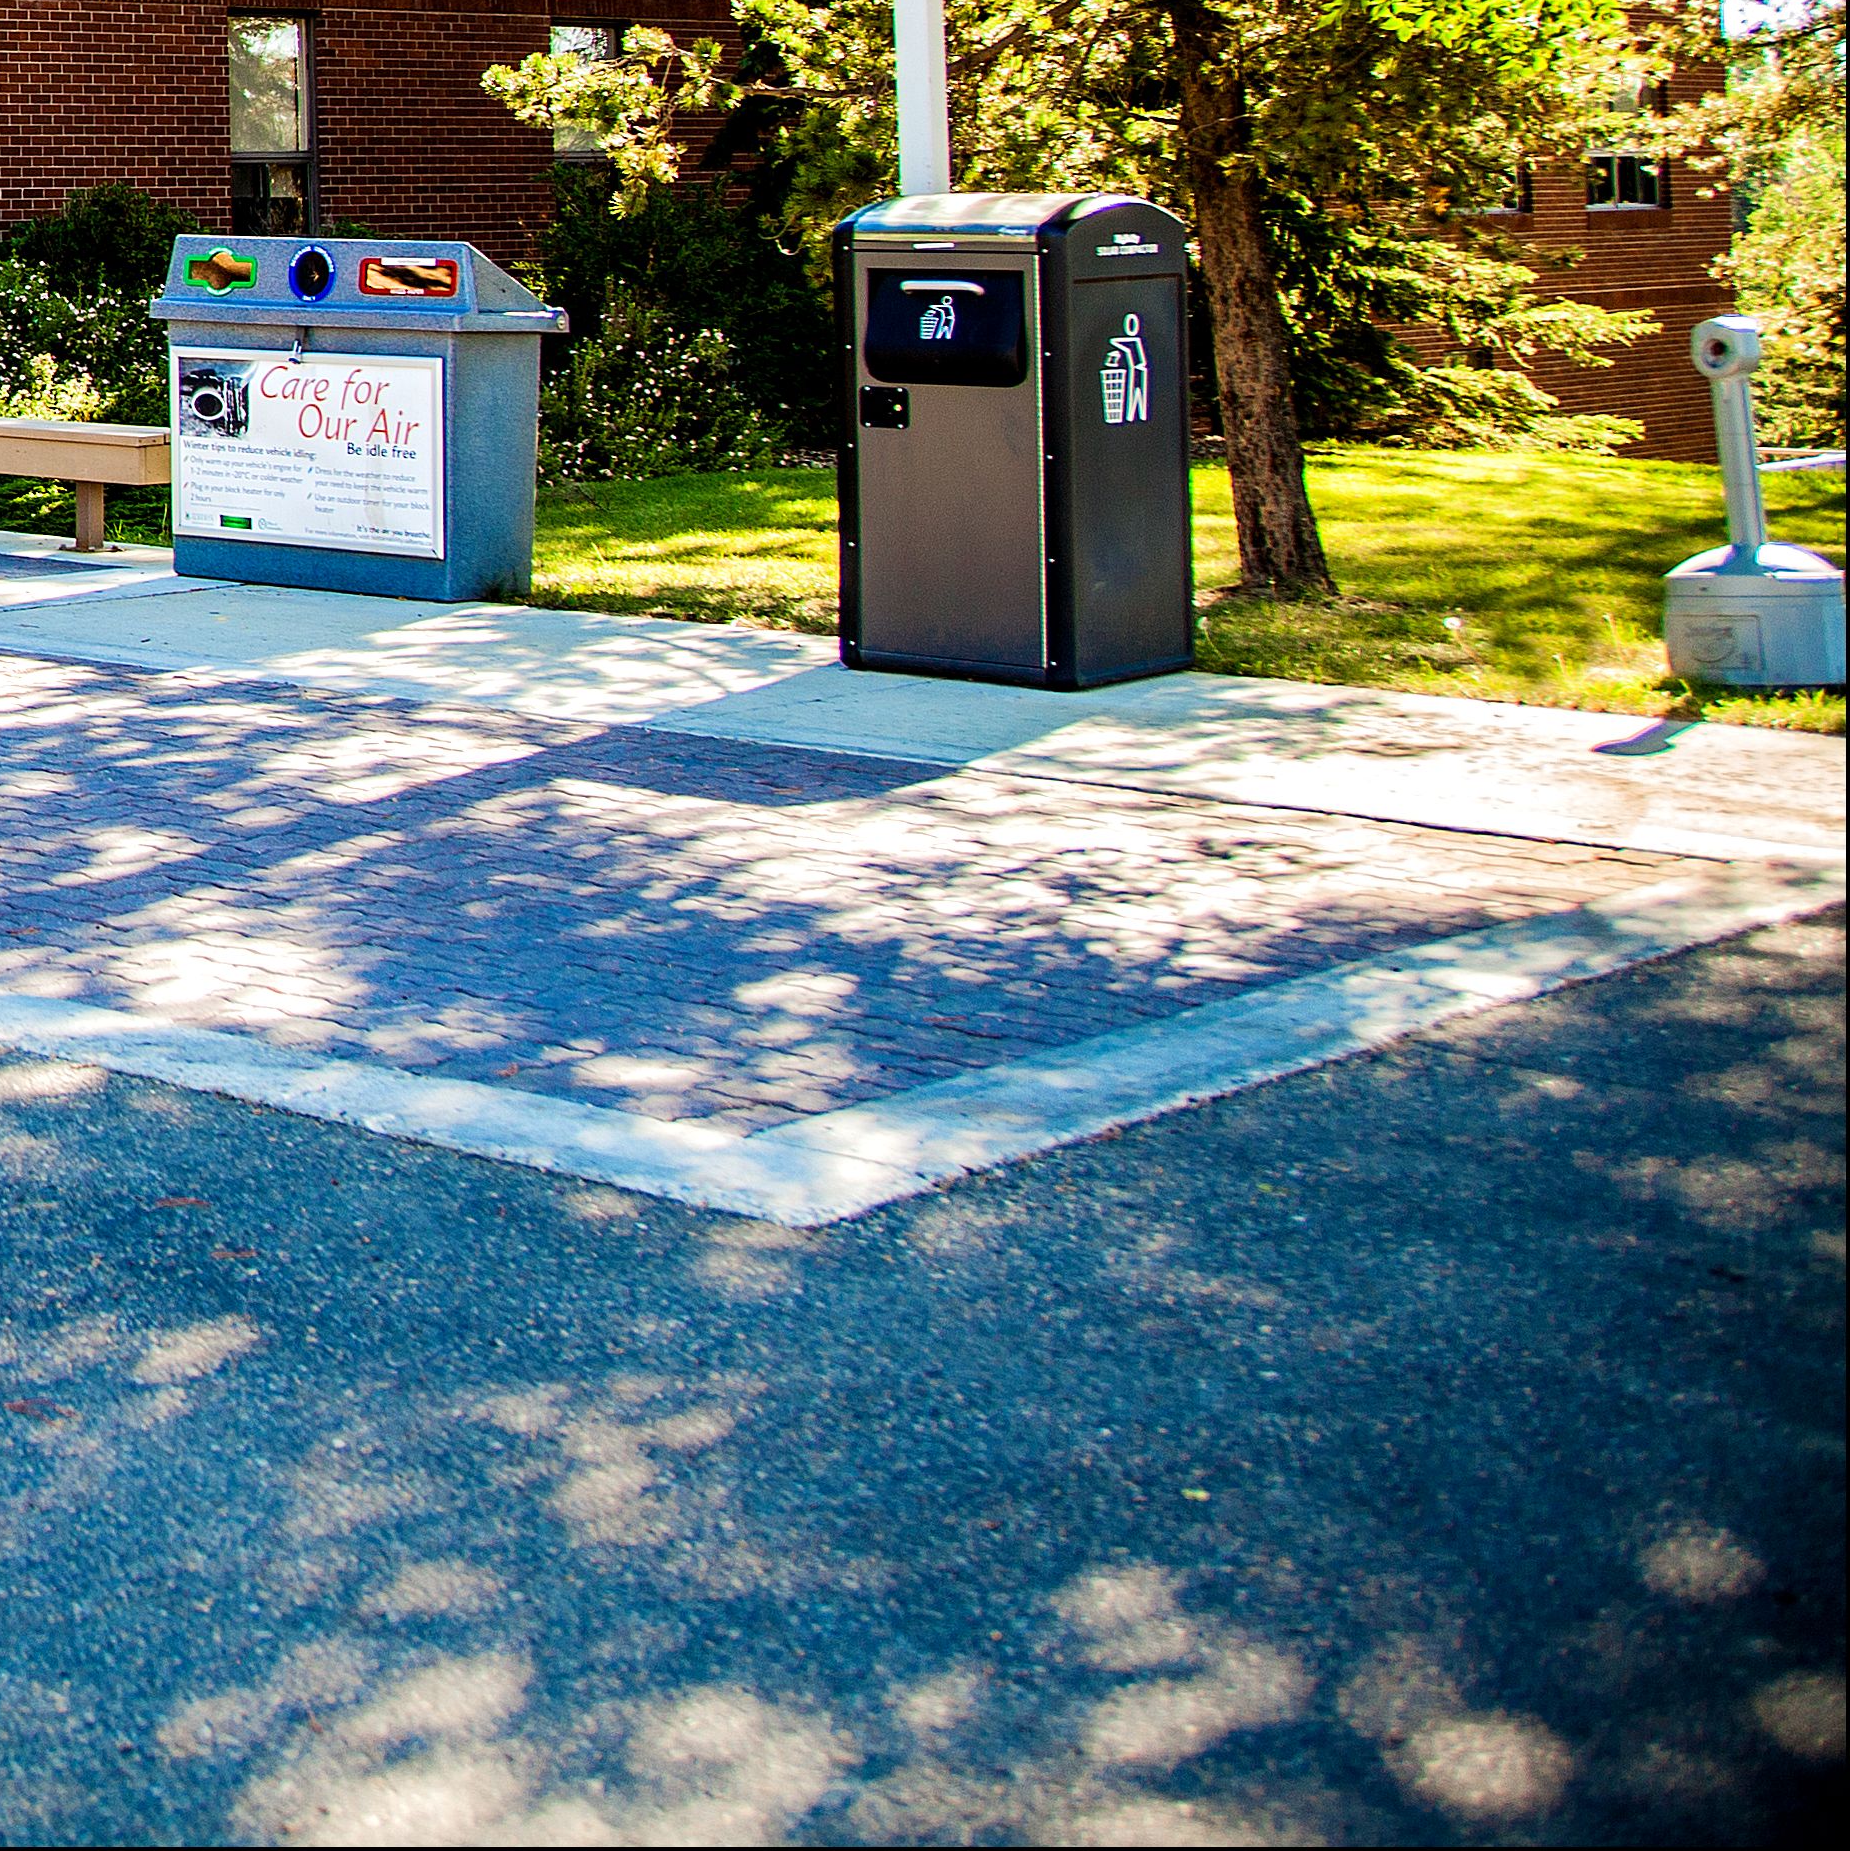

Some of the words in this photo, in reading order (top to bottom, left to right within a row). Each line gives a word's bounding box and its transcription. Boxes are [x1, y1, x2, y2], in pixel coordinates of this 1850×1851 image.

[260, 365, 329, 401] Care
[341, 368, 390, 410] for
[298, 403, 357, 441] Our
[366, 408, 419, 445] Air
[183, 439, 208, 450] Winter
[211, 443, 225, 453] tips
[238, 445, 264, 454] reduce
[266, 447, 291, 457] vehicle
[347, 442, 362, 455] Be
[366, 444, 387, 457] idle
[392, 445, 416, 459] free
[273, 464, 291, 472] engine
[333, 468, 342, 476] for
[344, 469, 353, 477] the
[356, 470, 381, 479] weather
[383, 472, 390, 480] to
[392, 473, 415, 482] reduce
[202, 469, 223, 477] minutes
[280, 475, 303, 483] weather
[225, 485, 240, 493] block
[242, 486, 262, 494] heater
[263, 487, 273, 495] for
[354, 483, 368, 492] keep
[370, 484, 381, 492] the
[383, 485, 406, 493] vehicle
[195, 494, 211, 502] hours
[337, 496, 360, 504] outdoor
[363, 498, 380, 506] timer
[382, 499, 391, 507] for
[393, 500, 408, 509] your
[410, 501, 429, 510] block
[357, 524, 367, 533] It's
[392, 529, 403, 537] you
